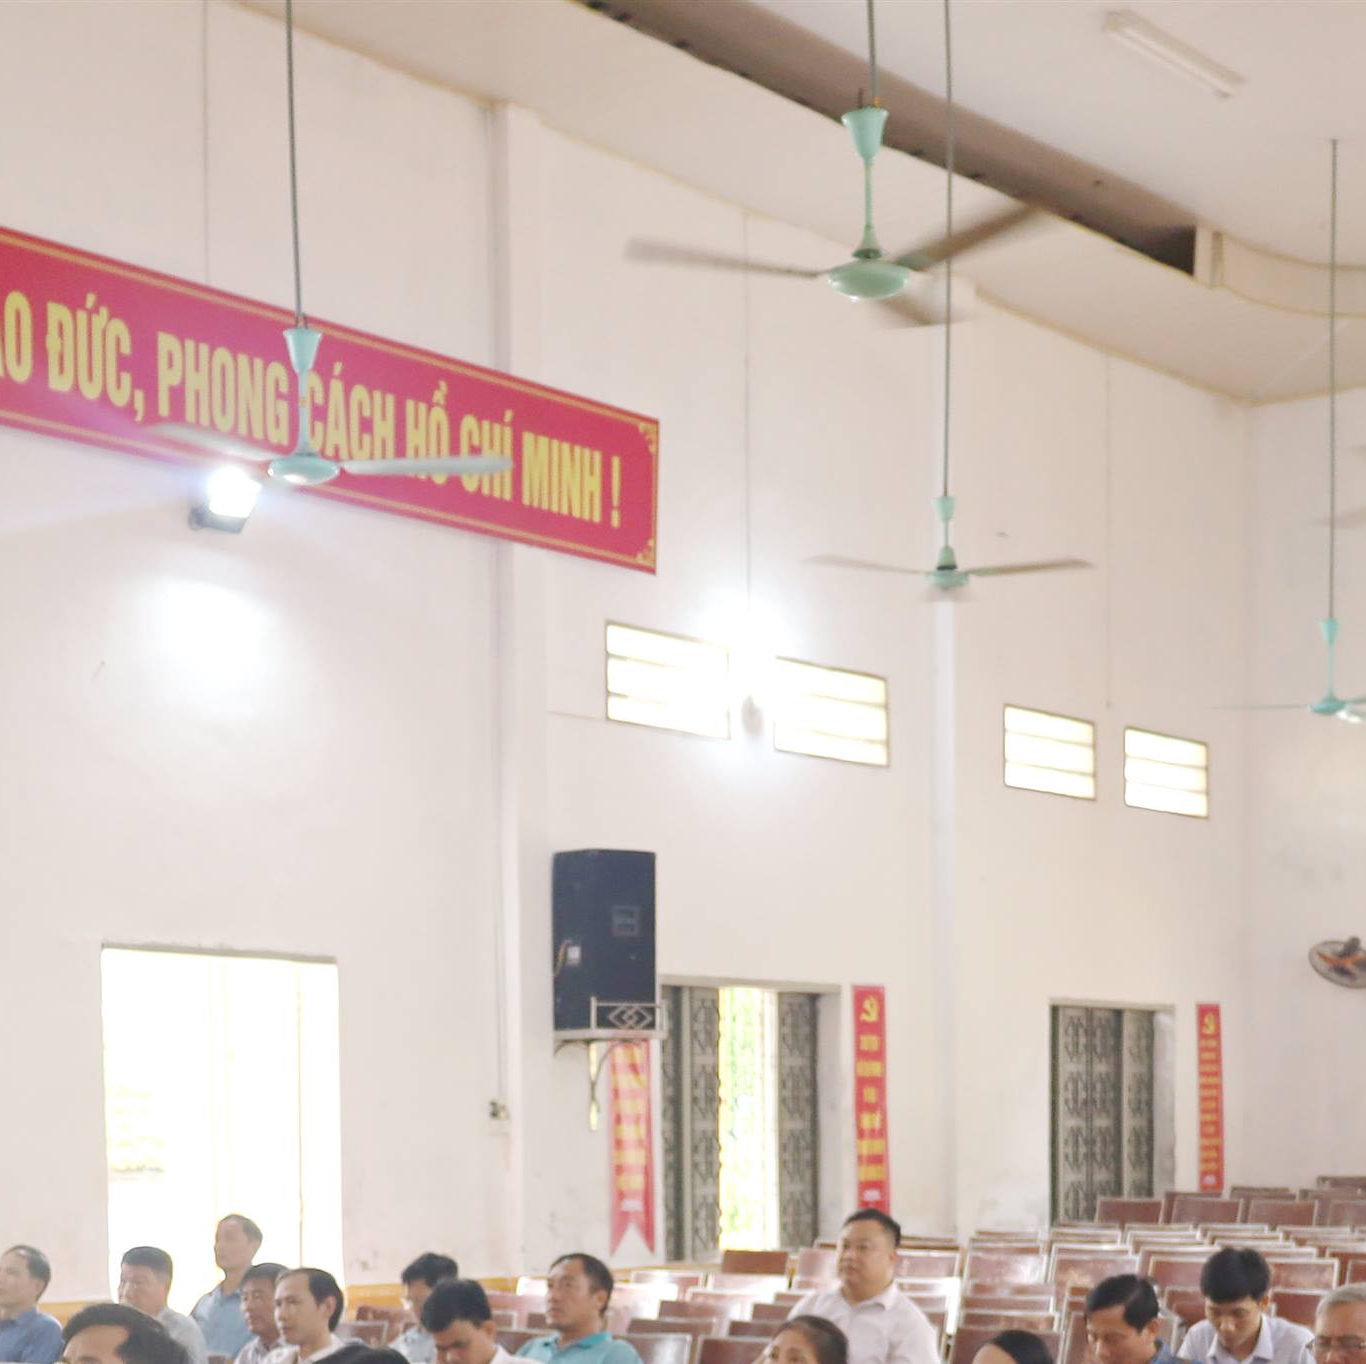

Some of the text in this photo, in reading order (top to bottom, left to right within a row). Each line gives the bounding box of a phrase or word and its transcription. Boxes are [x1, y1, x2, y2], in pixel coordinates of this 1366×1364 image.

[46, 293, 146, 422] ĐỨC,
[157, 331, 290, 447] PHONG
[306, 362, 395, 465] CÁCH
[405, 380, 451, 486] HỒ
[460, 409, 515, 502] CHÍ
[522, 431, 603, 525] MINH
